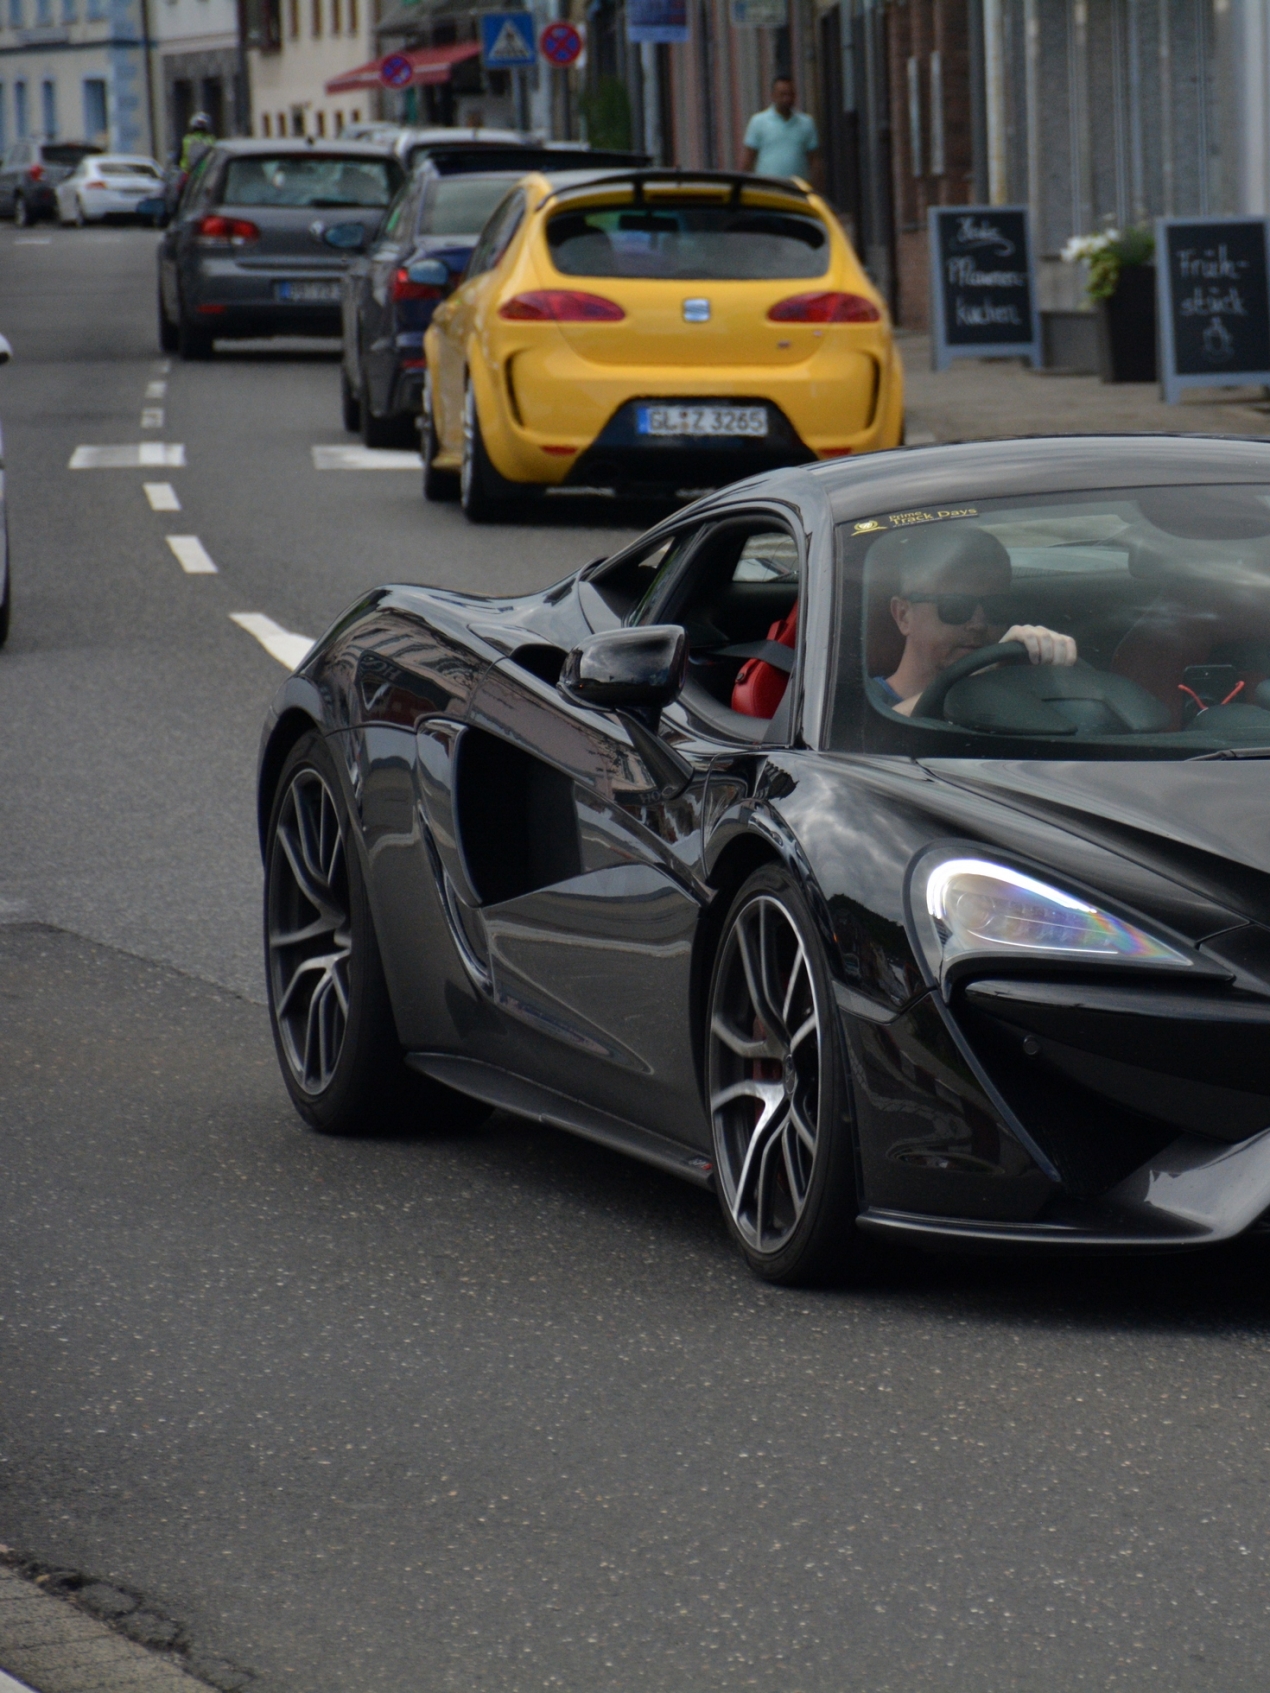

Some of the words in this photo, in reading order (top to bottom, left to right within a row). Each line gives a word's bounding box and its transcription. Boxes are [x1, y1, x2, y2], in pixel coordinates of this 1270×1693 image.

[1179, 286, 1249, 316] stück
[650, 409, 677, 431] GL
[711, 409, 764, 433] 3265
[889, 511, 922, 522] Prime
[892, 513, 932, 525] Track
[937, 508, 977, 519] Days
